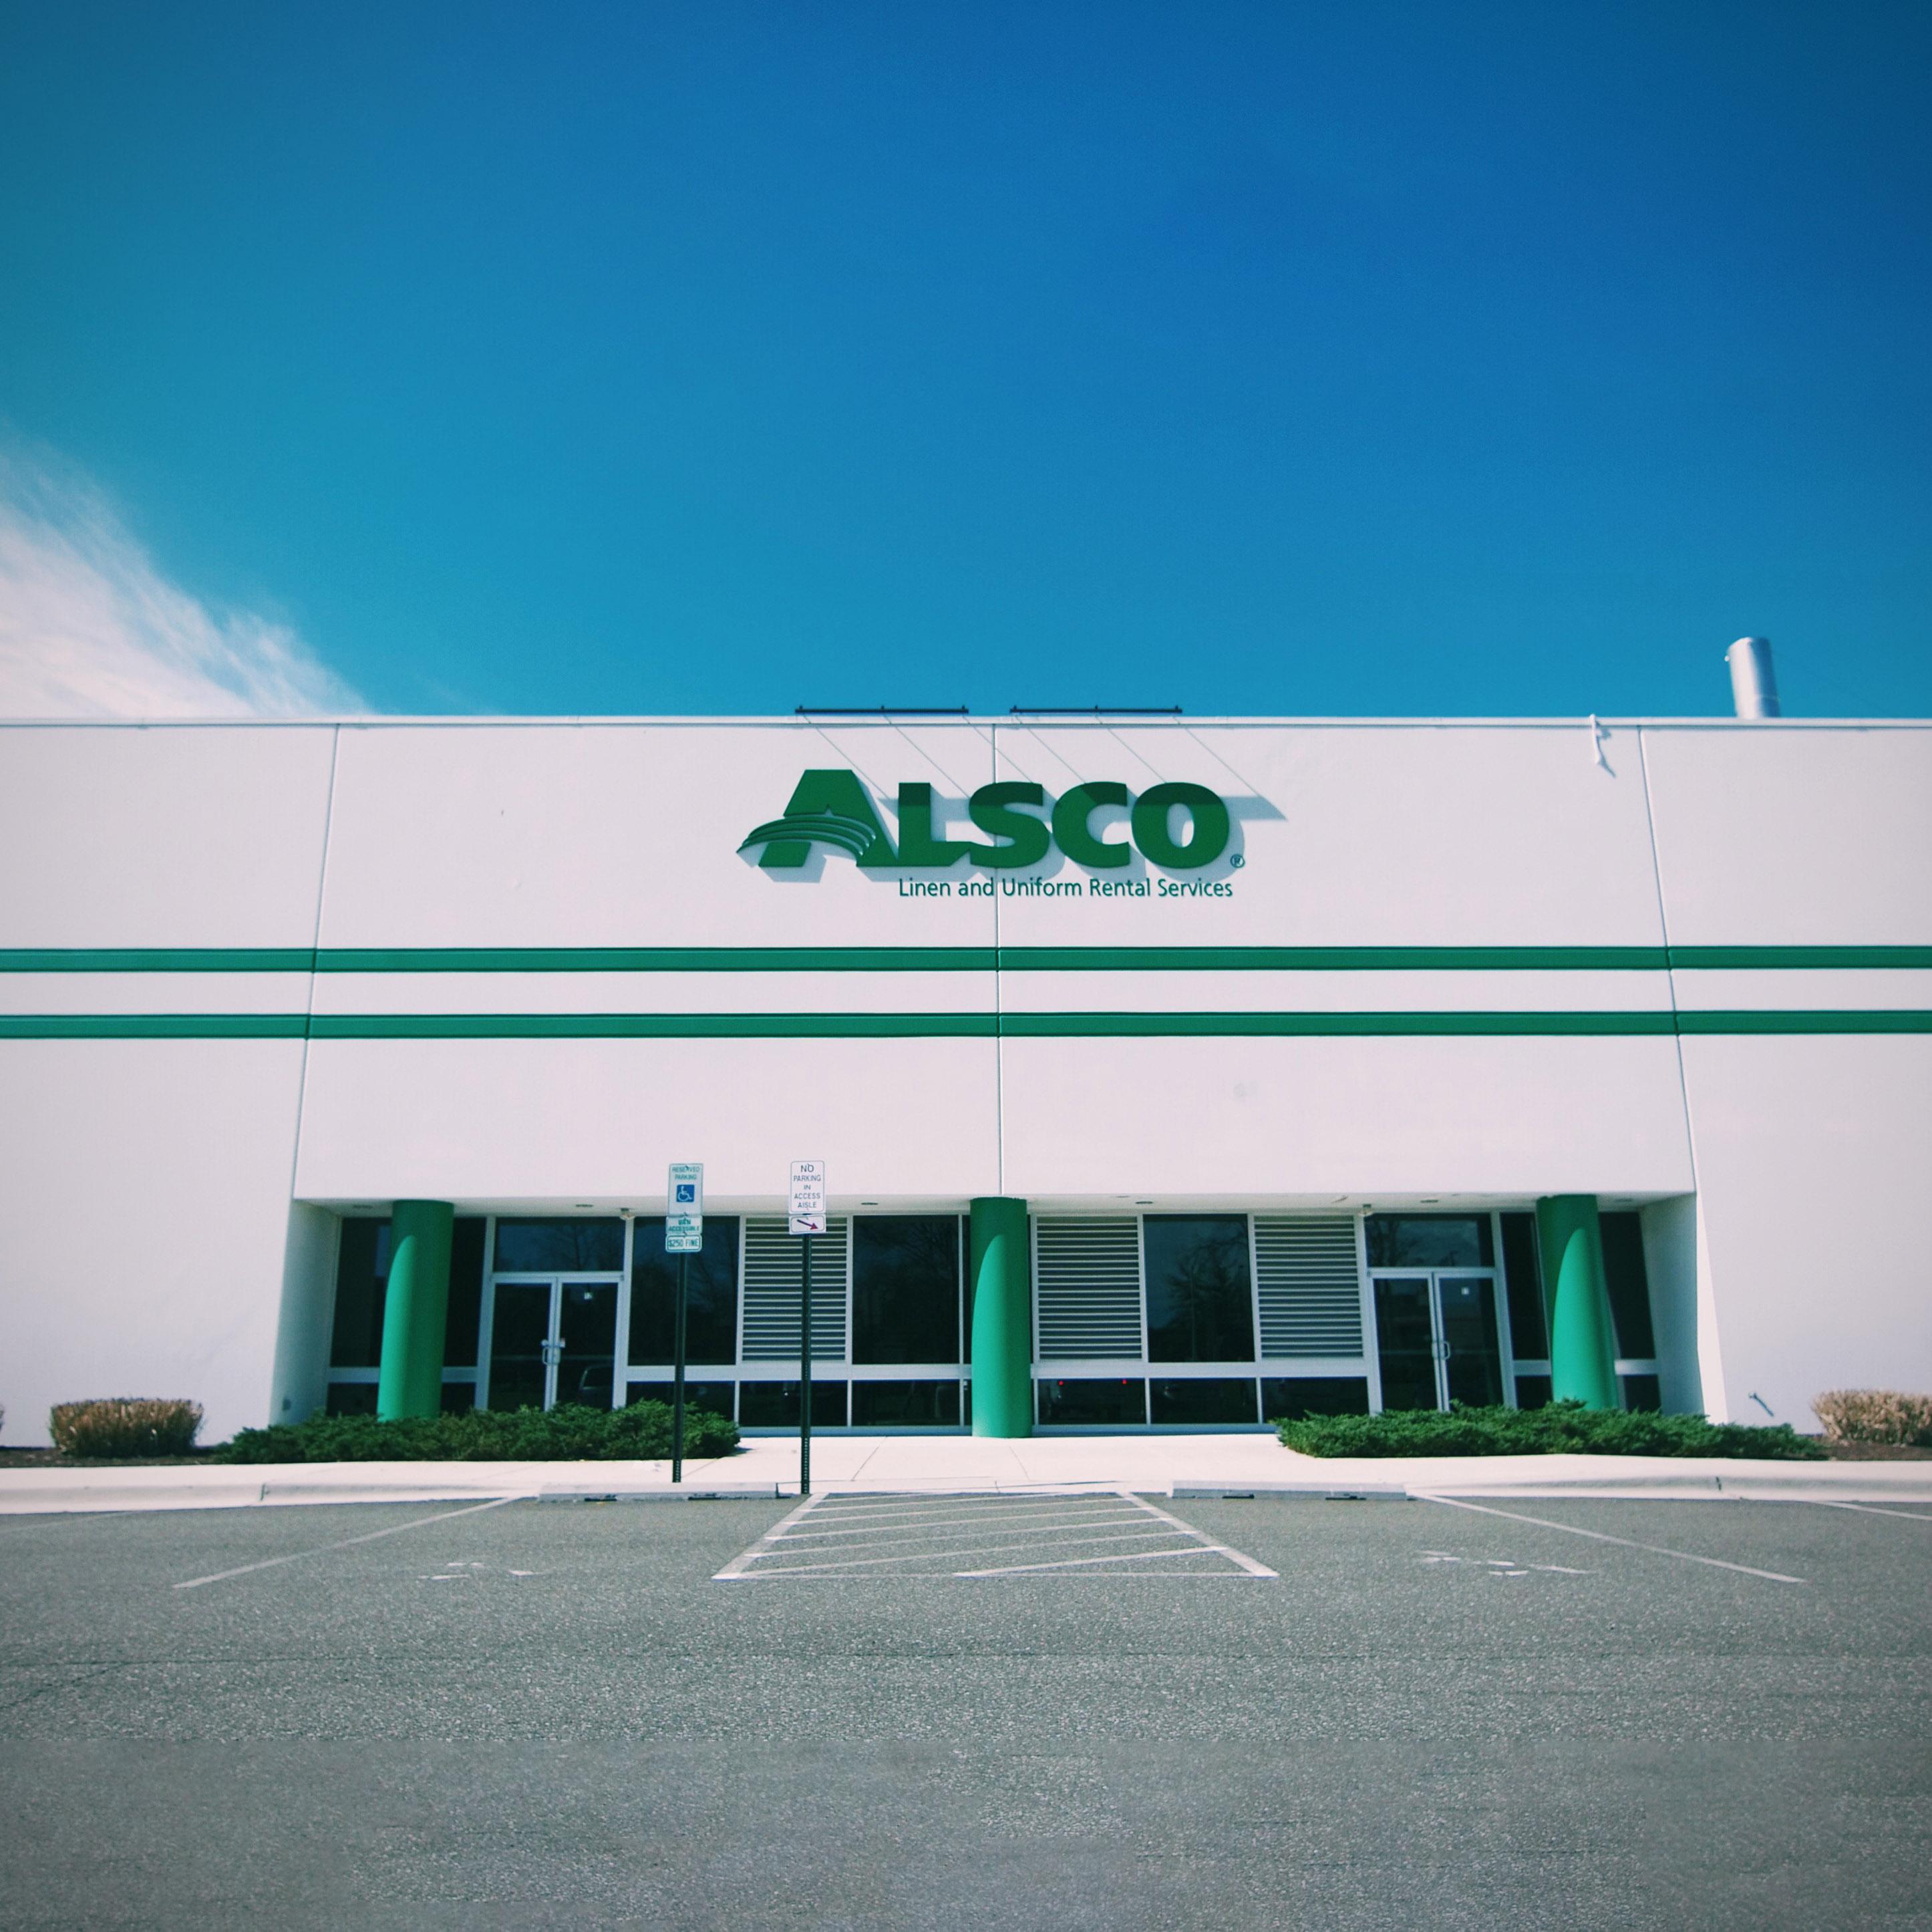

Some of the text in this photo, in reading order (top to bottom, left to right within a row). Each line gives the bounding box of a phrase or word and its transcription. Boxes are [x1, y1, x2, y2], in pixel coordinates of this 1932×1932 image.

[736, 769, 1230, 869] ALSCO
[899, 877, 1233, 897] Linen and Uniform Rental Services
[800, 1164, 814, 1173] NO
